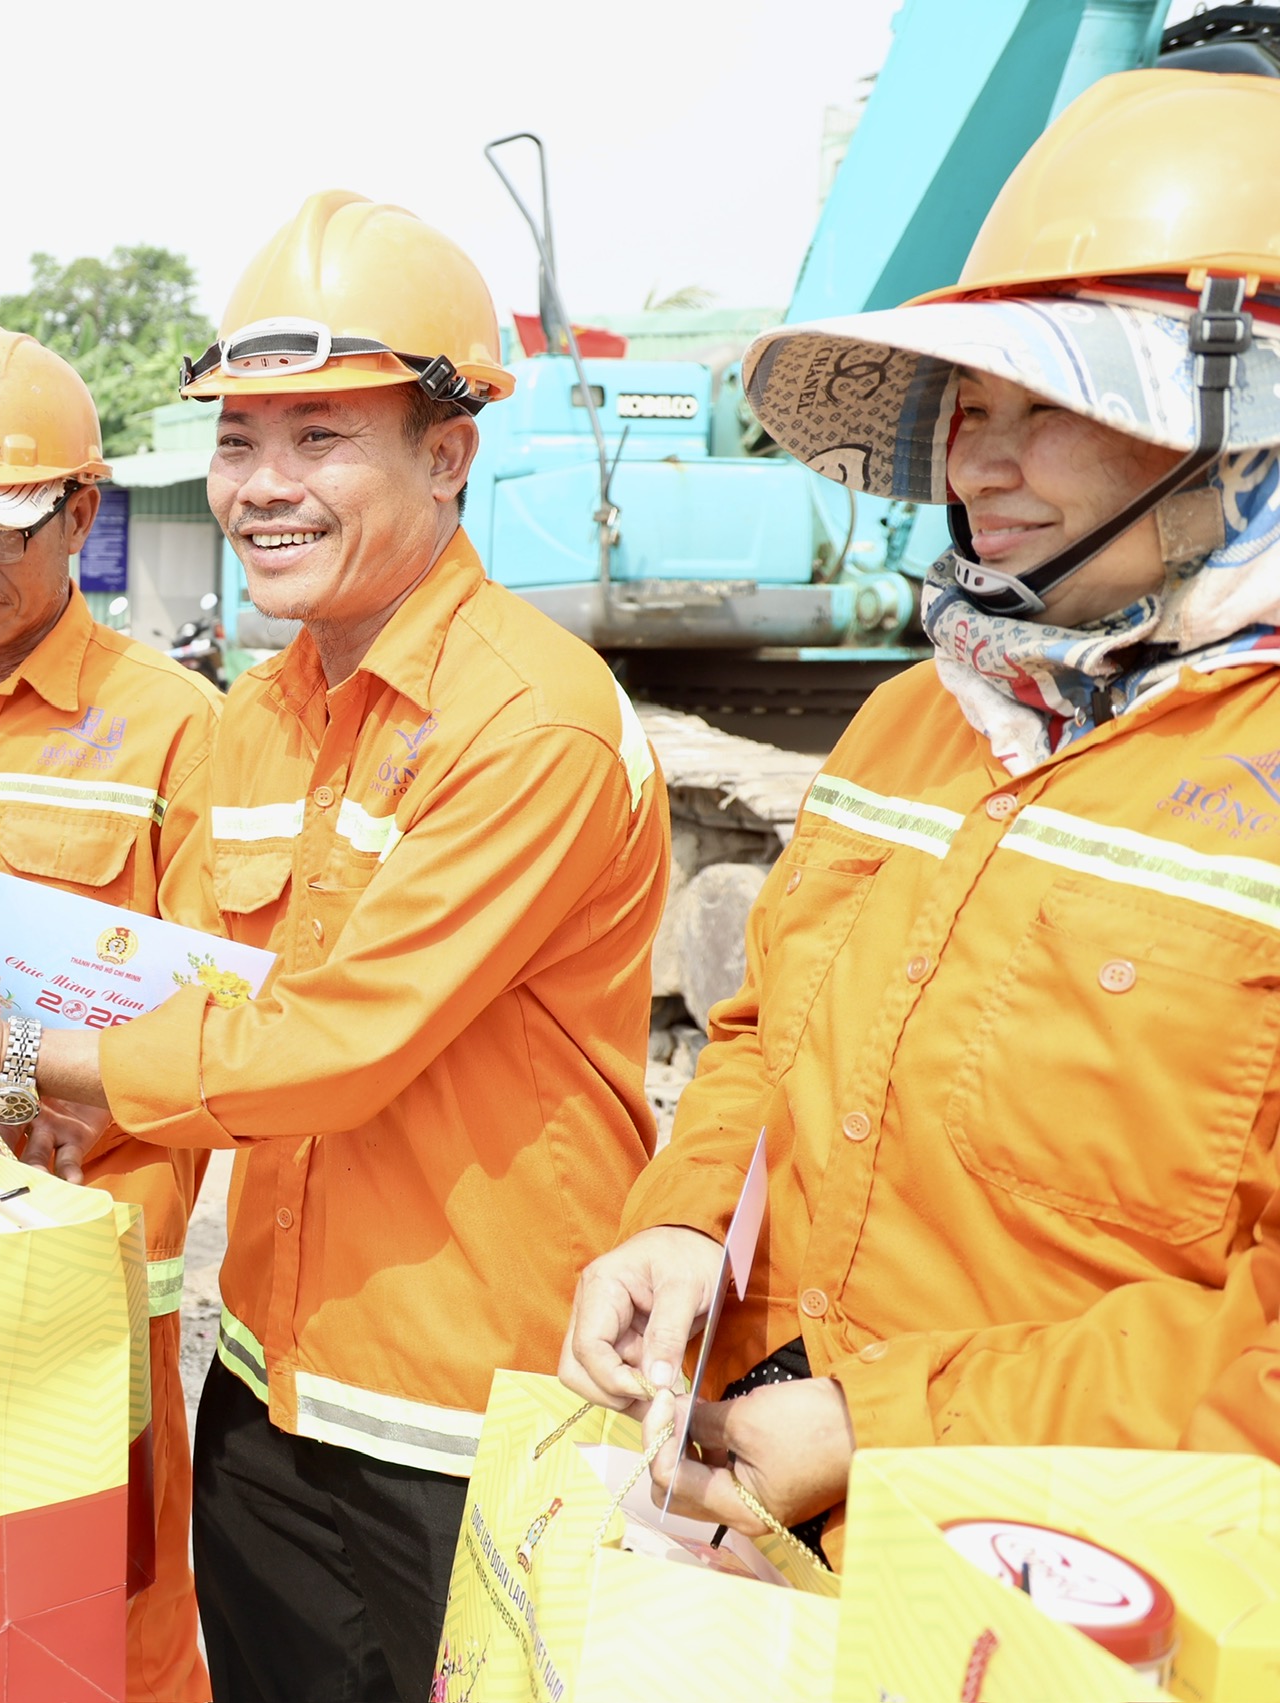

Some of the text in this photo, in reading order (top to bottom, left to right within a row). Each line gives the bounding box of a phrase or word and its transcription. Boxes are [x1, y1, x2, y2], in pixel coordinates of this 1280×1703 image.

[796, 347, 833, 414] CHANEL
[1168, 779, 1278, 833] HỒNG
[5, 956, 45, 979] Chúc
[46, 974, 97, 998] Mừng
[101, 989, 145, 1012] Năm
[124, 972, 142, 983] MINH
[508, 1577, 526, 1612] LAO
[543, 1660, 565, 1703] NAM
